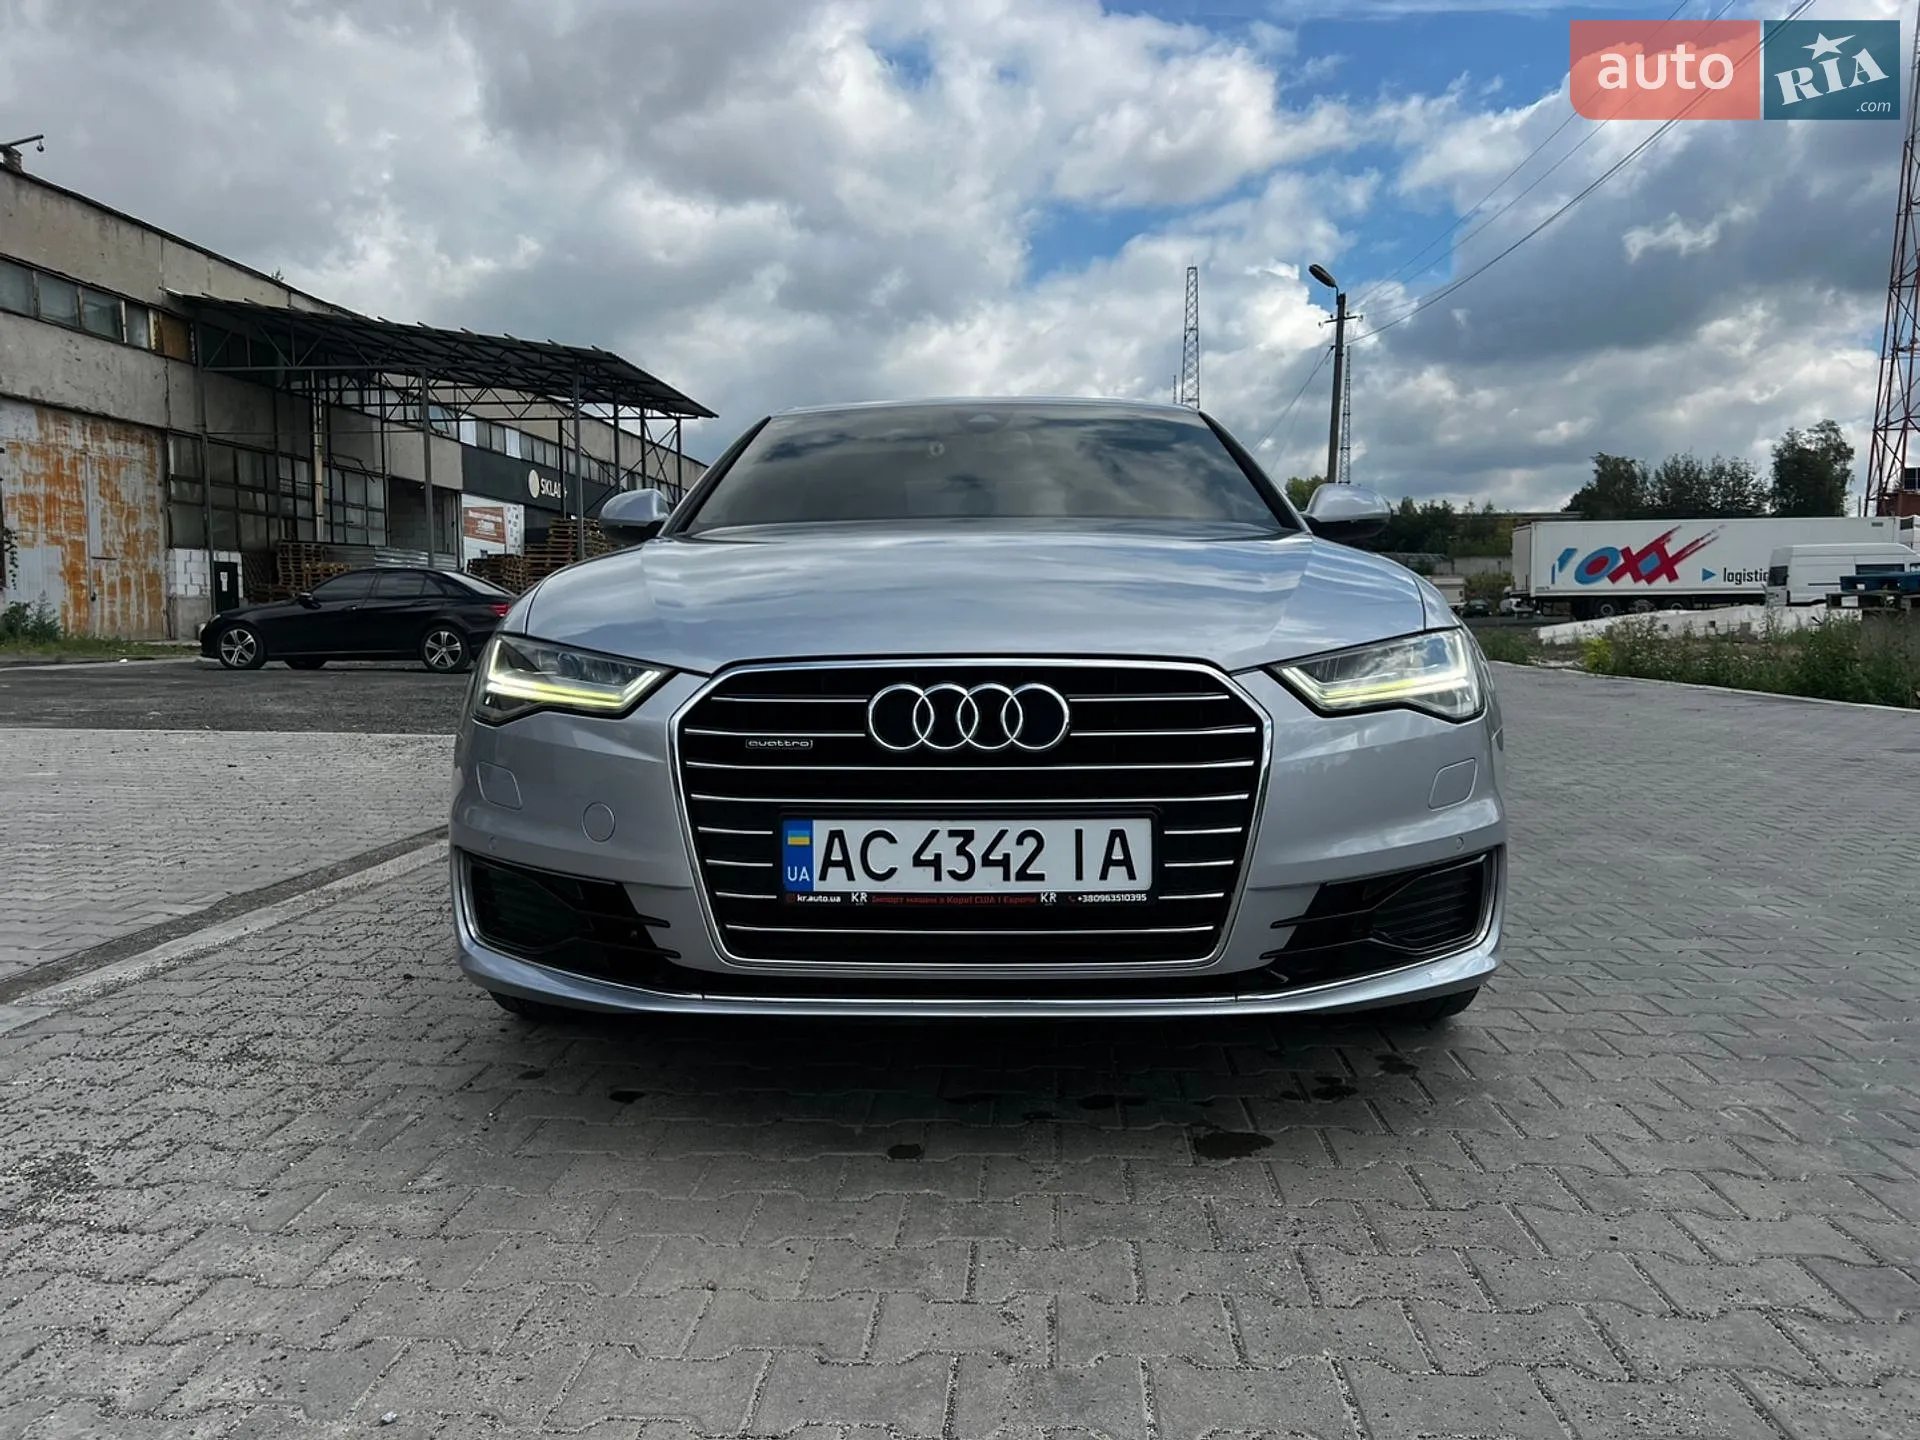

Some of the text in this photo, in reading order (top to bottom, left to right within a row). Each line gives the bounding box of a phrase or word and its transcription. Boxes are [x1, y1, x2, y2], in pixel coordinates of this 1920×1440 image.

[818, 828, 1137, 882] AC 4342 IA
[787, 866, 811, 882] UA
[797, 894, 841, 902] kr.auto.ua
[851, 892, 868, 902] KR
[1040, 892, 1057, 902] KR
